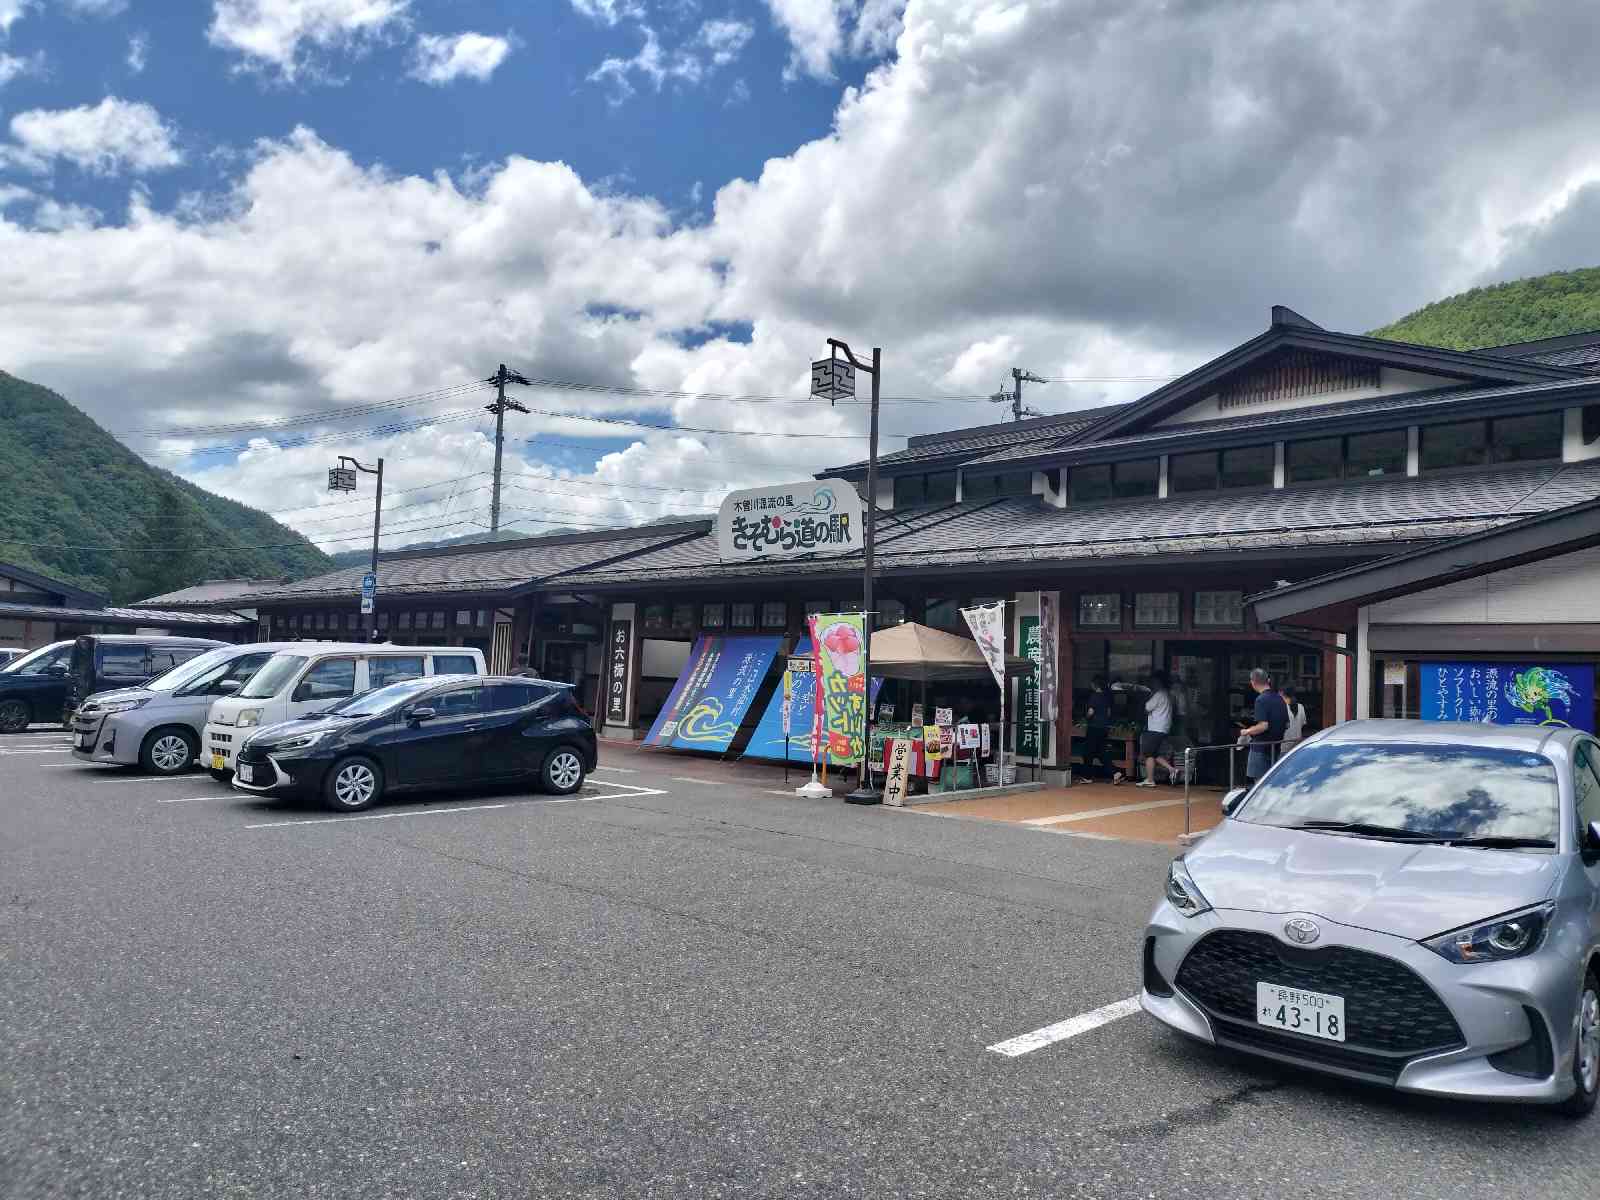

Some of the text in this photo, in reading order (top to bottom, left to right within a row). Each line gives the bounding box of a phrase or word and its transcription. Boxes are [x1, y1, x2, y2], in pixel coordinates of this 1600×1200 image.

[734, 495, 794, 513] 木曽川源流の里
[732, 513, 852, 551] きそむら道の駅
[1436, 667, 1449, 720] ひとやすみ
[1486, 668, 1499, 721] 源流の里の
[888, 743, 907, 801] 営業中
[1276, 1004, 1339, 1036] 43-18
